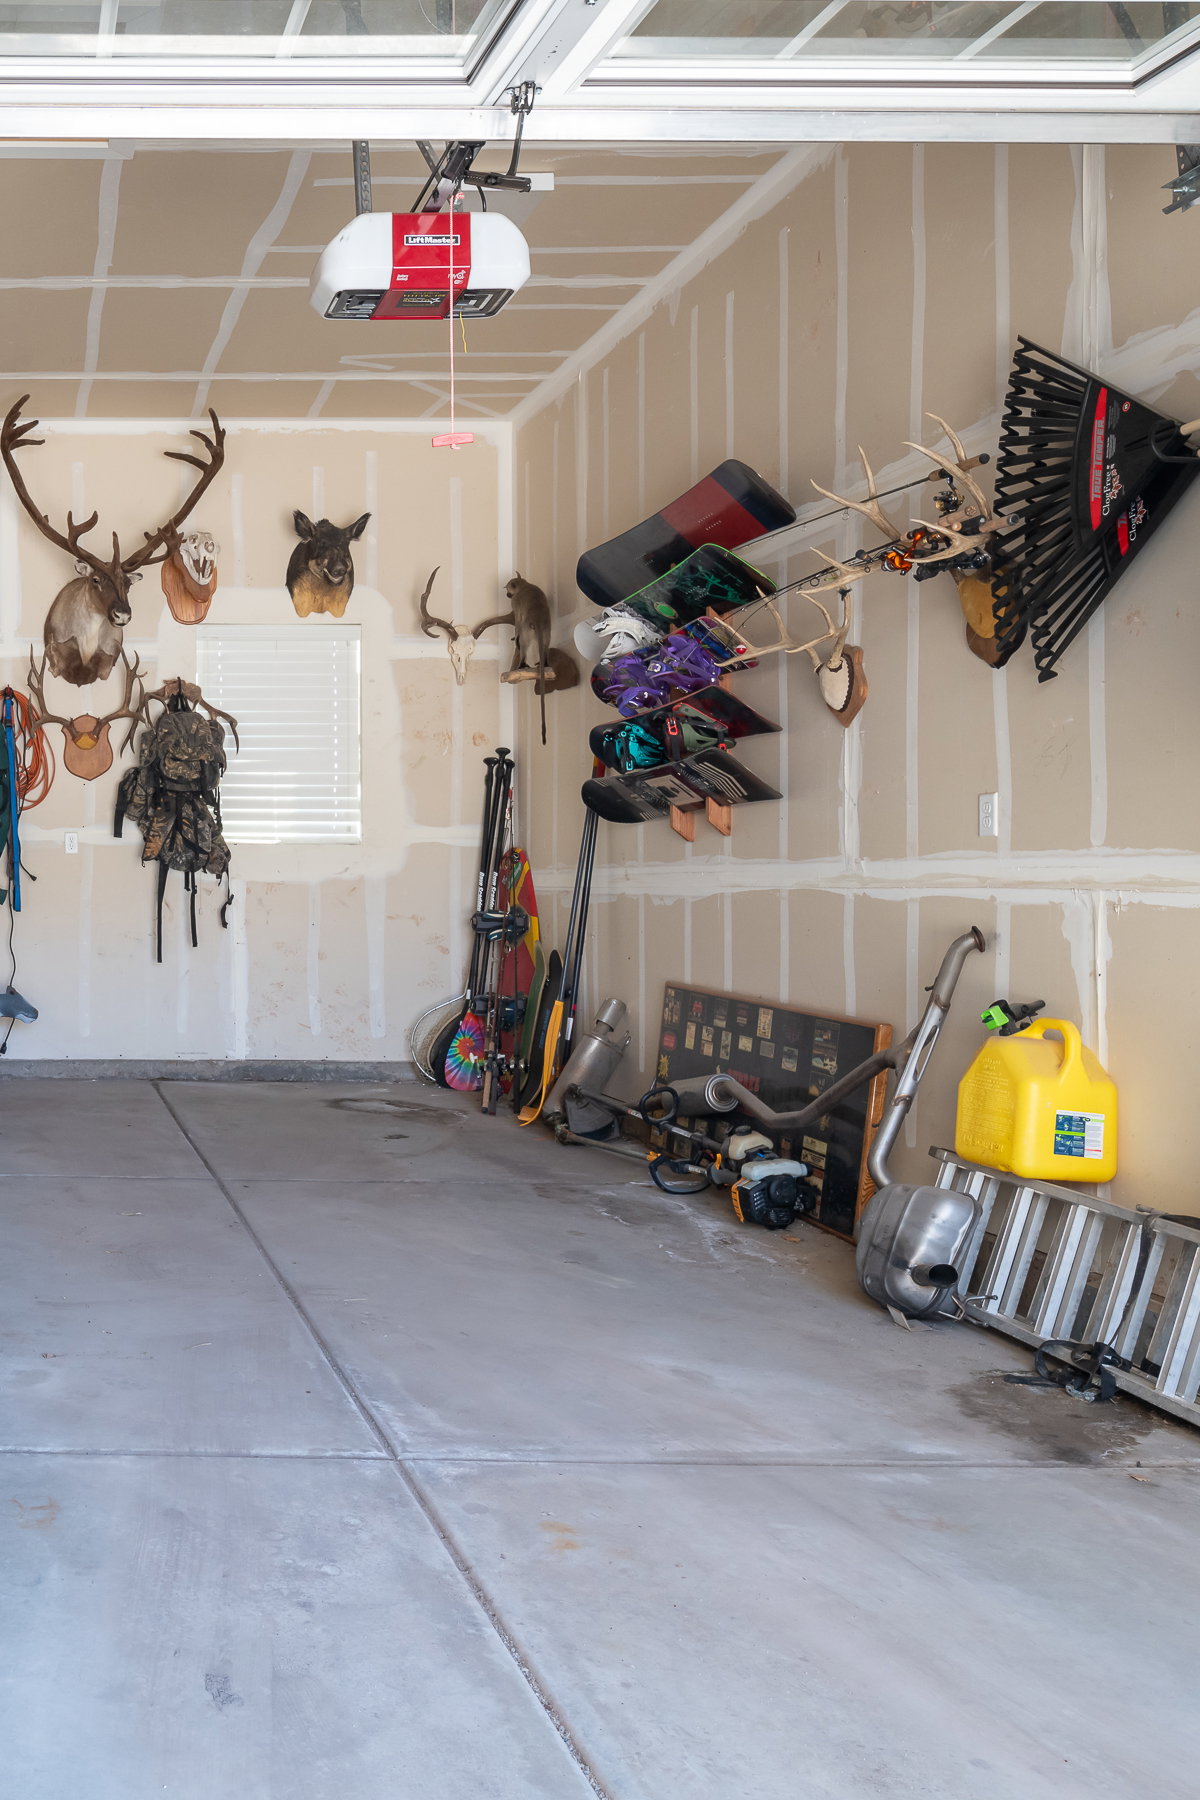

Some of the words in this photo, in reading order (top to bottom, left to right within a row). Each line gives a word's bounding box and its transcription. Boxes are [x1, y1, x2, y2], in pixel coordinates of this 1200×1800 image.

[408, 236, 456, 244] LiftMaster
[1093, 418, 1105, 467] TEMPER
[1091, 469, 1103, 502] TRUE
[1102, 471, 1112, 516] ClogFree
